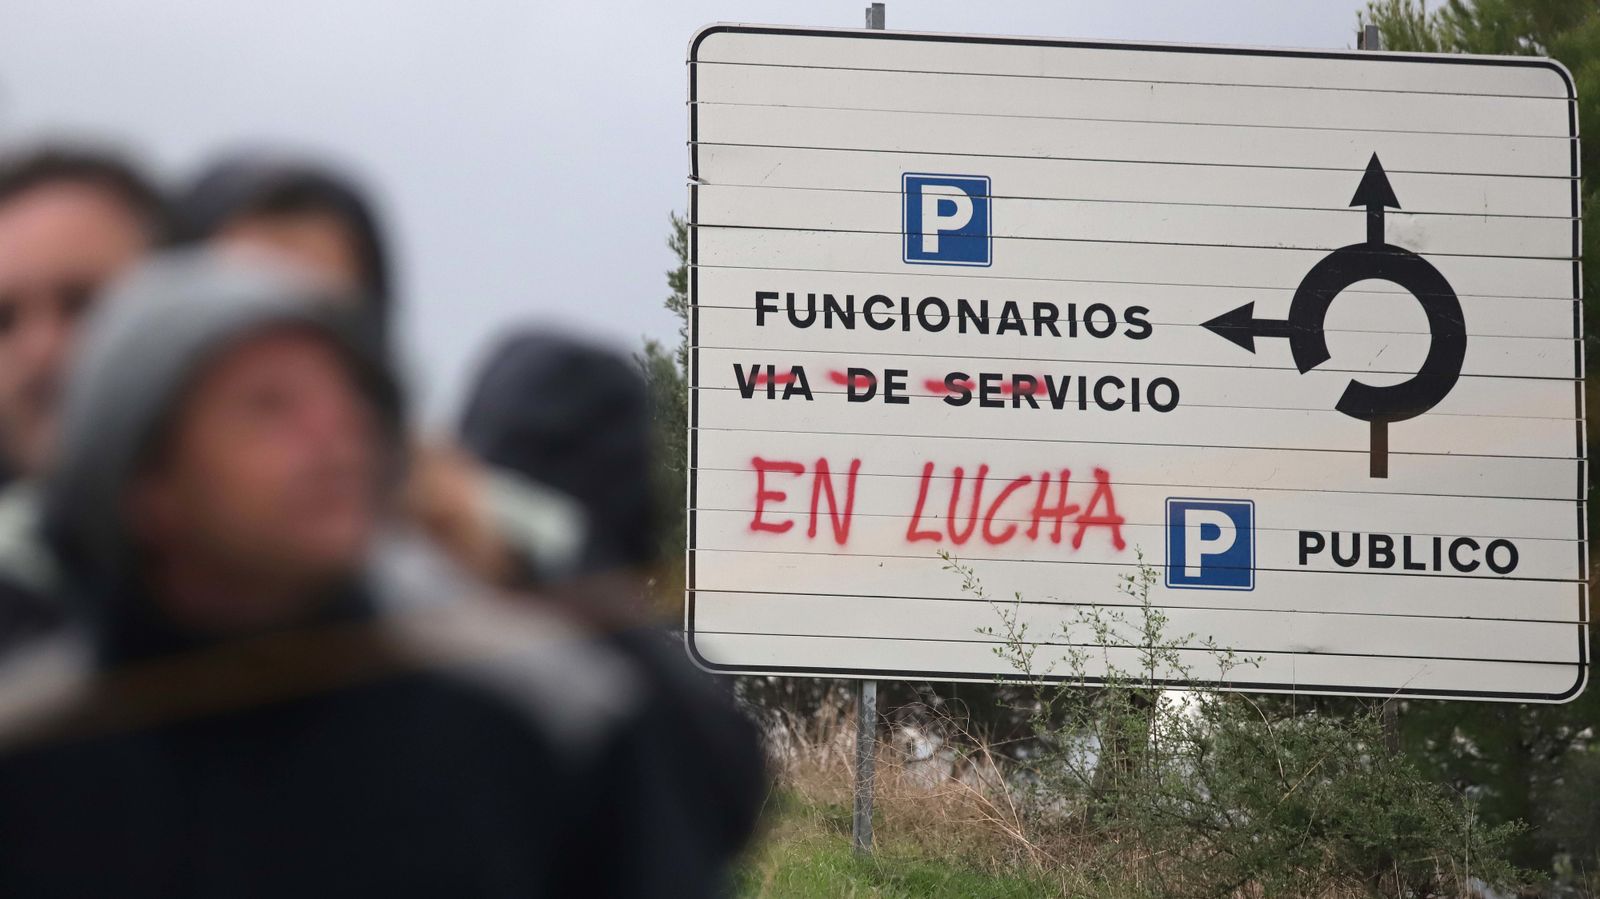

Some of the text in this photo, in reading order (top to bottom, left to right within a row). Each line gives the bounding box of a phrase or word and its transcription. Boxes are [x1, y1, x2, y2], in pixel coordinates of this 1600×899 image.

[921, 184, 974, 253] P
[755, 291, 1153, 340] FUNCIONARIOS
[733, 363, 1180, 413] VIA DE SERVICIO
[750, 456, 1126, 551] EN LUCHA
[1185, 508, 1519, 577] P PUBLICO
